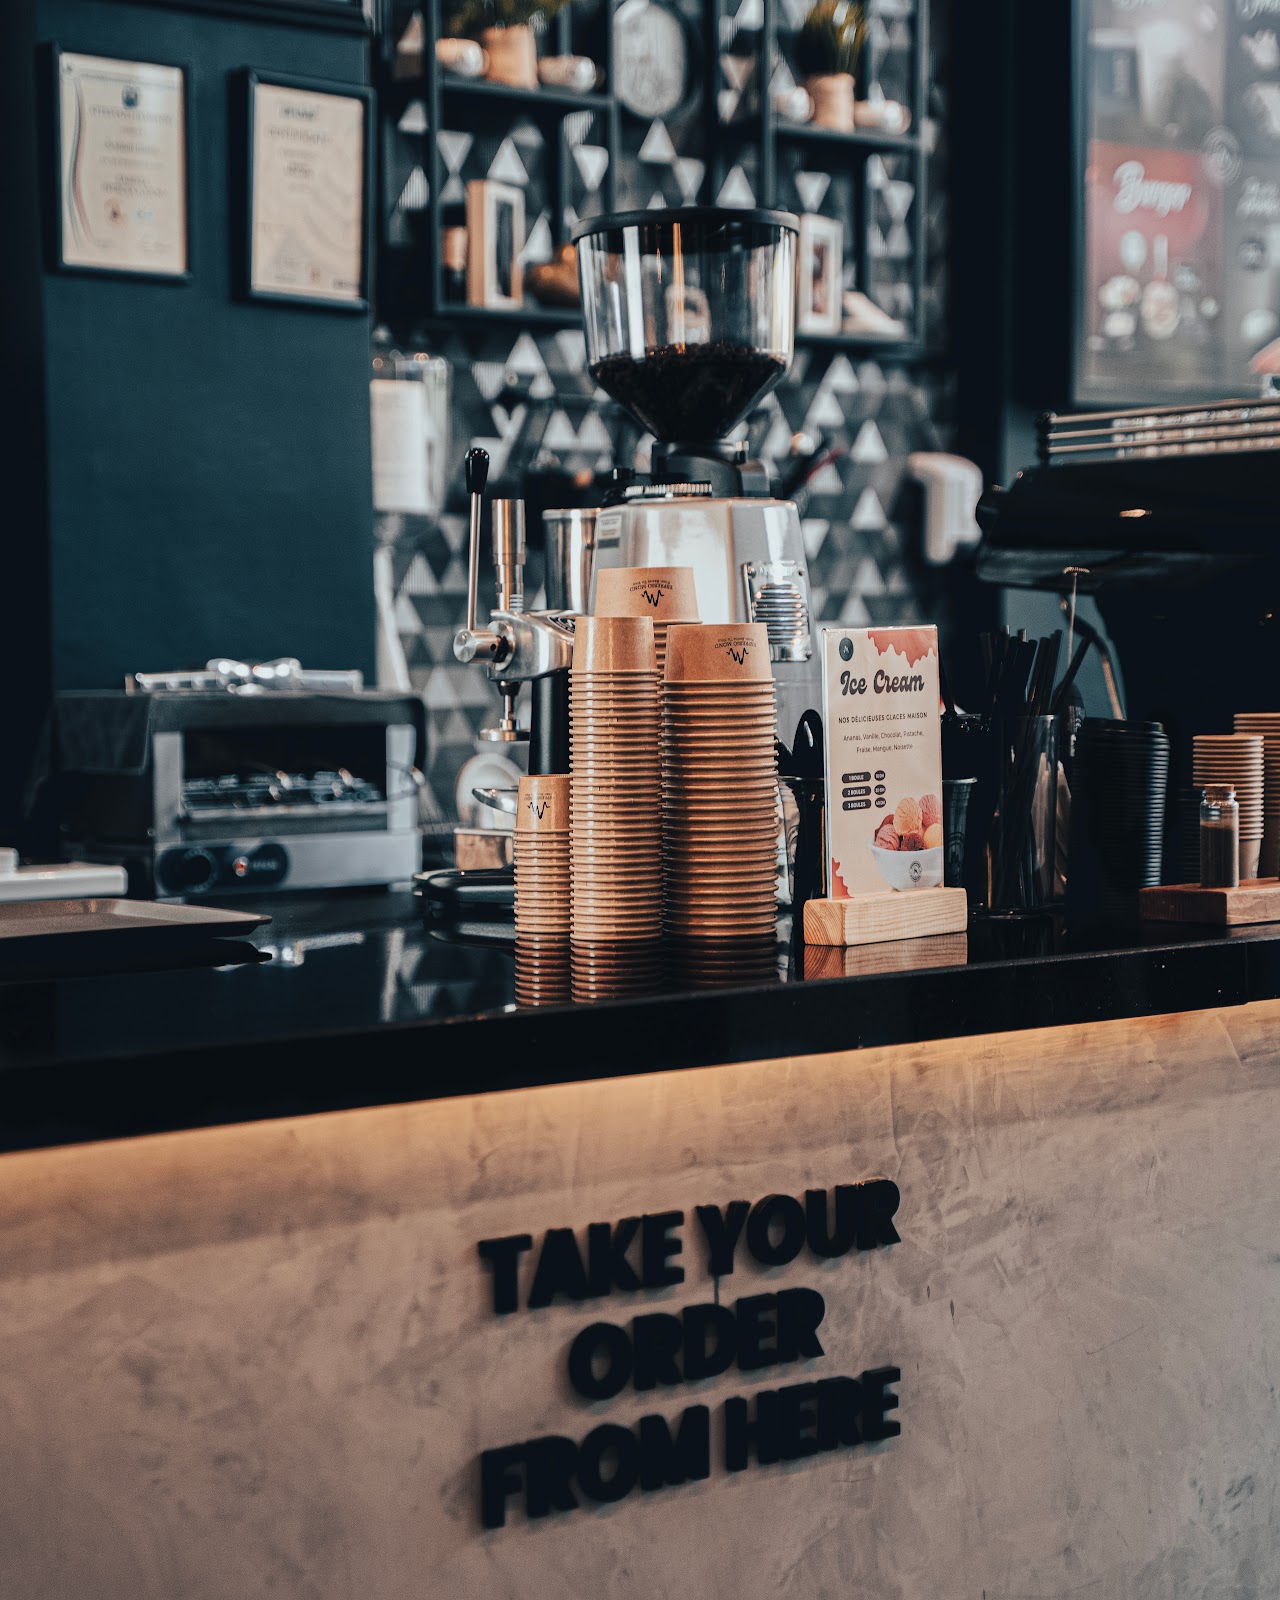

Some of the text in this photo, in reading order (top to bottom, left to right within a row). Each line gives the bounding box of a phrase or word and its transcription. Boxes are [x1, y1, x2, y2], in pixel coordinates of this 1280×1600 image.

[838, 716, 850, 724] NOS
[851, 714, 885, 723] DÉLICIEUSES
[907, 711, 928, 719] MAISON
[840, 669, 925, 696] Ice Cream
[477, 1178, 902, 1315] TAKE YOUR
[568, 1287, 826, 1401] ORDER
[481, 1366, 901, 1530] FROM HERE
